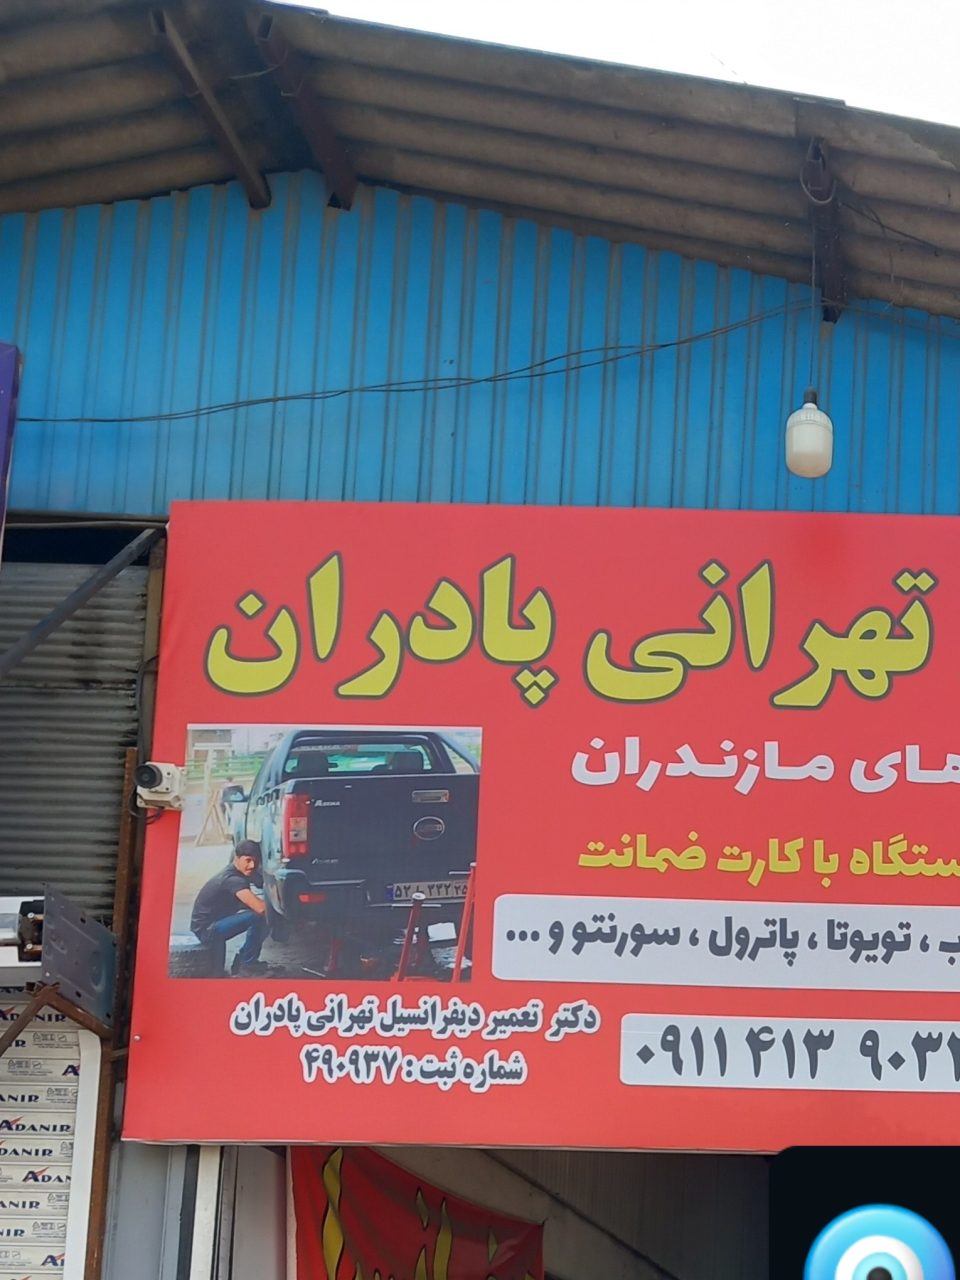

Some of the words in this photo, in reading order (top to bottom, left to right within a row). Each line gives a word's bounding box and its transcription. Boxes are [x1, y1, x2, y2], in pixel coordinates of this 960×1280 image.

[204, 551, 558, 708] پادران
[584, 560, 938, 710] تهرانی
[571, 736, 835, 796] مازندران
[578, 831, 707, 874] ضمانت
[717, 837, 804, 887] کارت
[813, 839, 840, 888] با
[231, 993, 301, 1034] پادران
[304, 995, 376, 1035] تهرانی
[483, 1000, 542, 1038] تعمیر
[546, 1001, 600, 1039] دکتر
[463, 1051, 527, 1091] شماره
[0, 1118, 71, 1132] ADANIR
